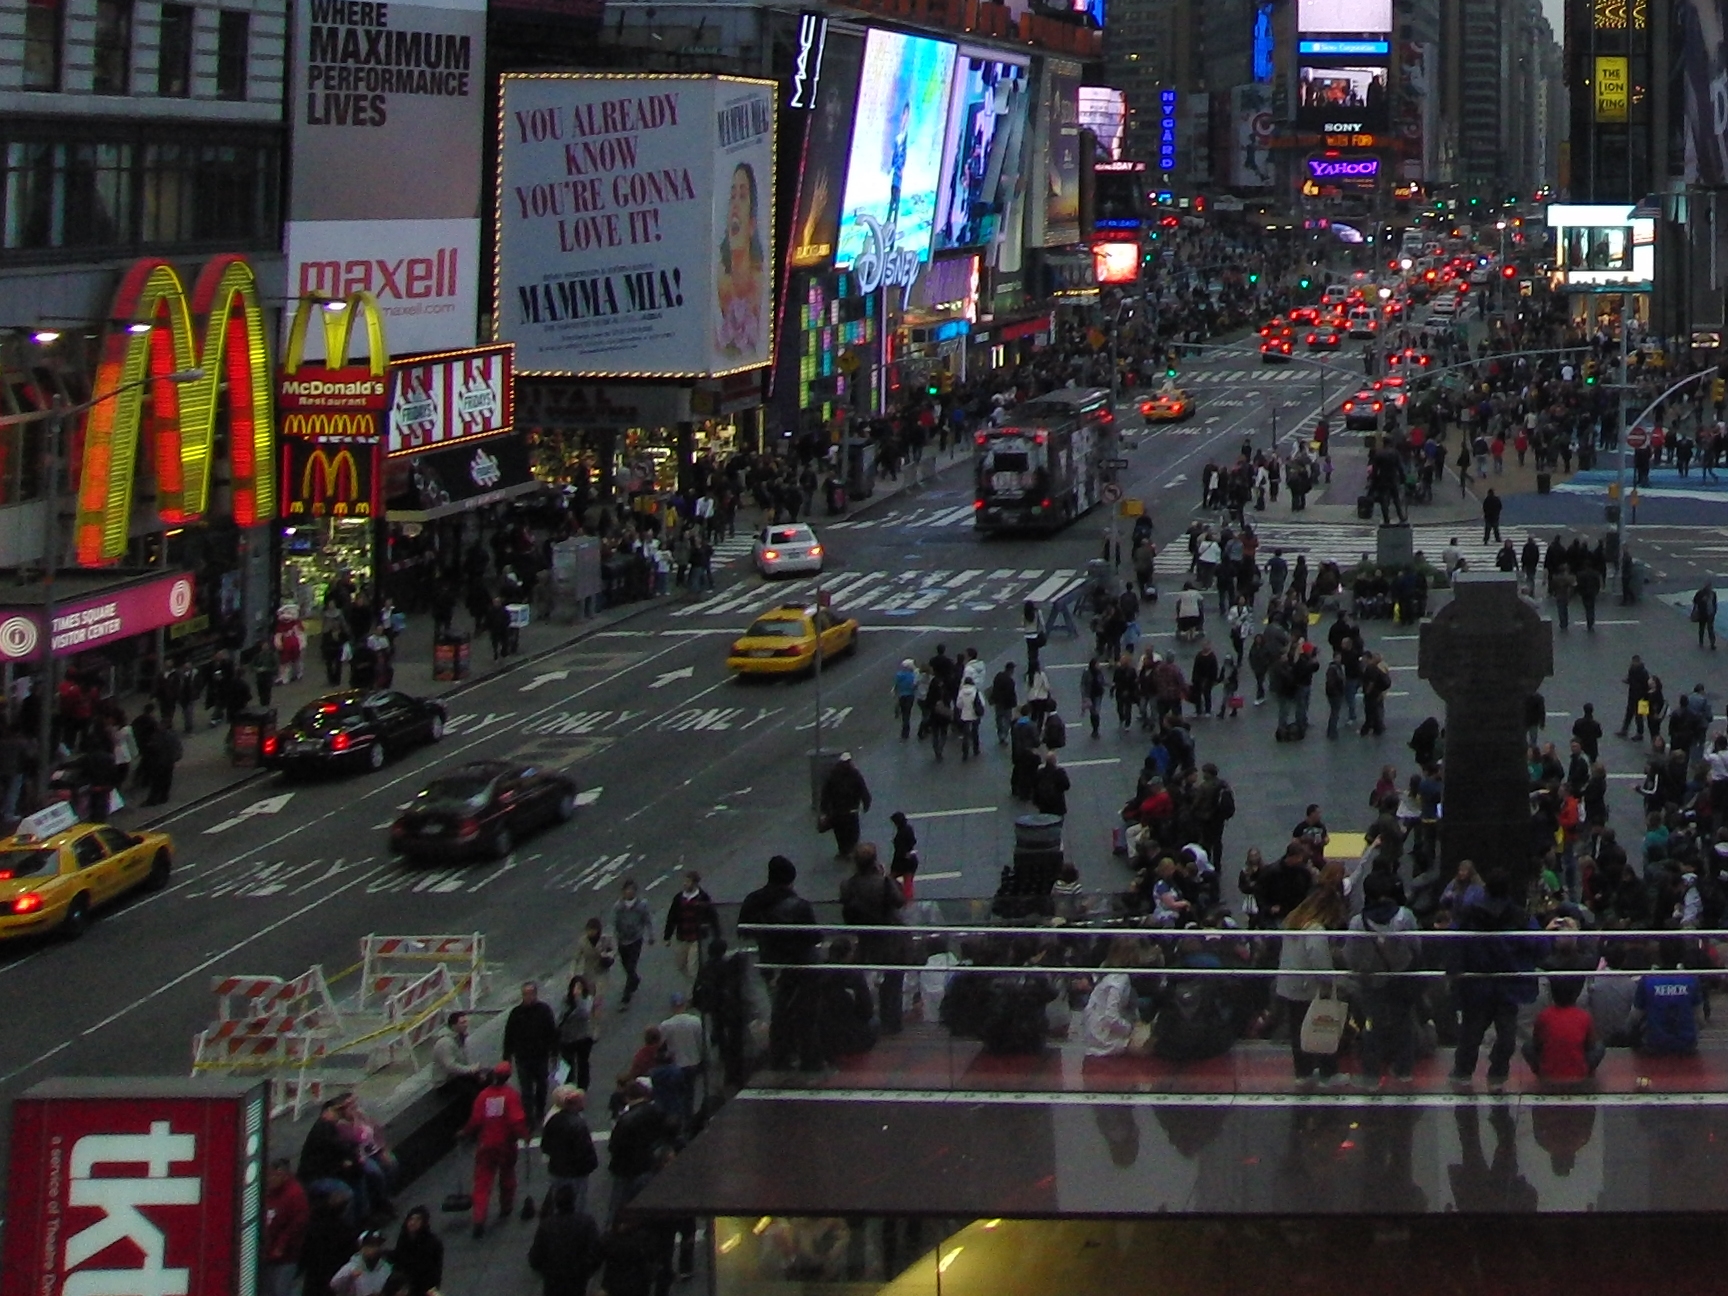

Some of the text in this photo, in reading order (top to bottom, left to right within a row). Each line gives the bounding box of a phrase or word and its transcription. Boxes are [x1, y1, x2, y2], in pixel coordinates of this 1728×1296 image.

[309, 26, 470, 70] MAXIMUM
[308, 65, 469, 96] PERFORMANCE
[1599, 81, 1623, 96] LION
[1602, 69, 1620, 77] THE
[307, 93, 386, 126] LIVES
[515, 93, 679, 143] YOU ALREADY
[1599, 99, 1625, 113] KING
[1324, 123, 1362, 132] SONY
[564, 136, 638, 176] KNOW
[1309, 161, 1379, 176] YAHOO!
[516, 168, 696, 219] YOU'RE GONNA
[559, 208, 662, 252] LOVE IT!
[300, 248, 458, 299] maxell
[519, 276, 619, 324] MAMMA
[626, 268, 683, 312] MIA!
[283, 381, 384, 396] McDonald's
[298, 396, 368, 406] Restaurant
[52, 602, 119, 632] TIMES SQUARE
[52, 618, 122, 650] VISITOR CENTER
[521, 709, 646, 735] ONLY
[1653, 984, 1689, 996] XEROX
[44, 1148, 62, 1270] service Theatre
